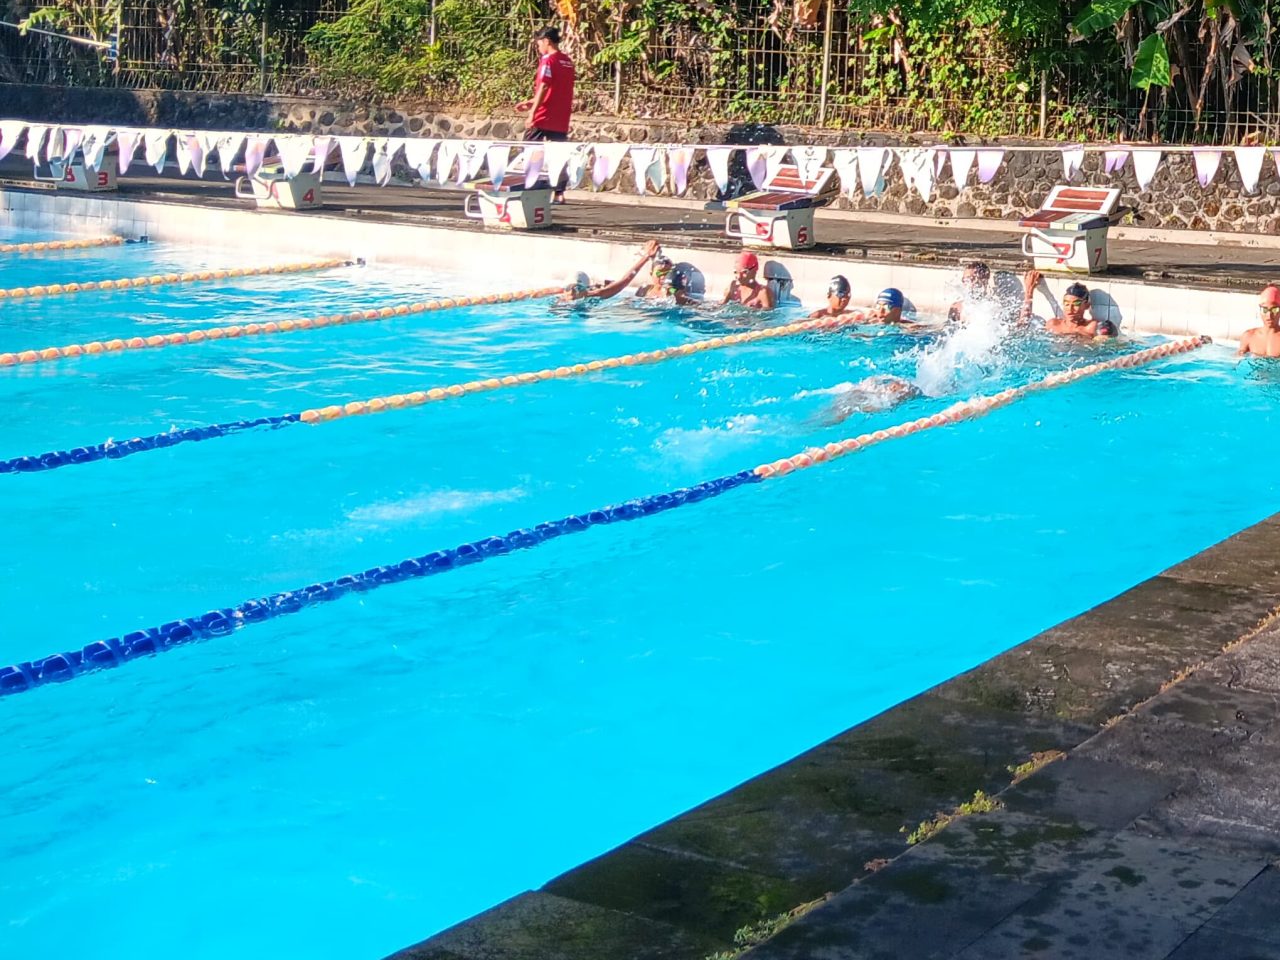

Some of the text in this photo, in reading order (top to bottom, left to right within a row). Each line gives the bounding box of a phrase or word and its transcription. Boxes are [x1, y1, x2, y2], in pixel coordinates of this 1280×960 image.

[97, 171, 108, 186] 3
[302, 188, 315, 204] 4
[534, 207, 545, 224] 5
[797, 227, 808, 244] 6
[1052, 242, 1072, 265] 7
[1094, 247, 1103, 267] 7
